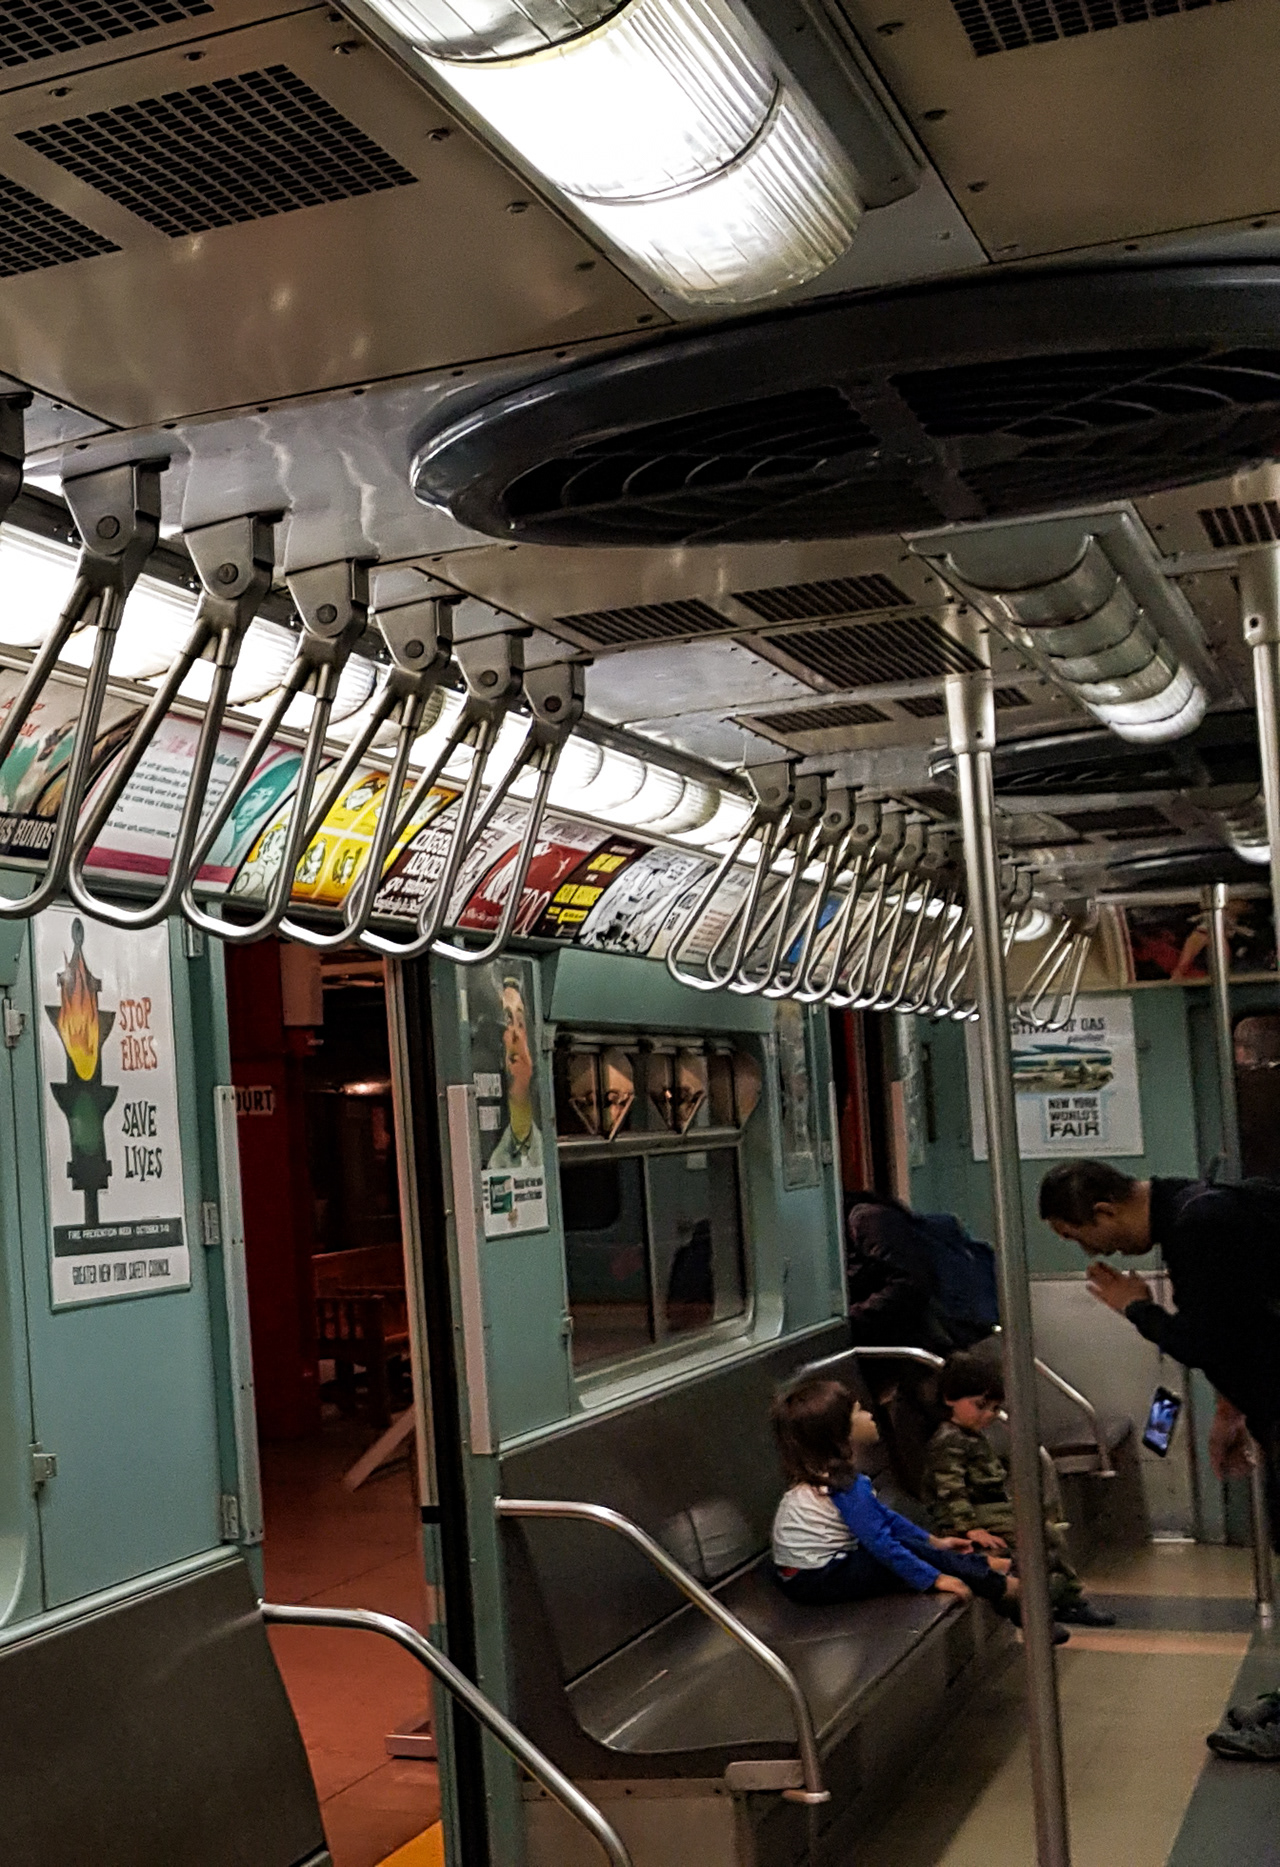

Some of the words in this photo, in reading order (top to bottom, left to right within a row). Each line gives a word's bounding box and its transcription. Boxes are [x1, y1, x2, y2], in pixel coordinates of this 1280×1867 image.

[13, 816, 57, 850] BONDS
[118, 997, 152, 1032] STOP
[121, 1034, 158, 1072] FIRES
[122, 1101, 157, 1139] SAVE
[1048, 1098, 1070, 1109] NEW
[1072, 1097, 1098, 1108] YORK
[1049, 1110, 1099, 1121] WORLD'S
[1050, 1120, 1099, 1137] FAIR
[124, 1145, 162, 1182] LIVES
